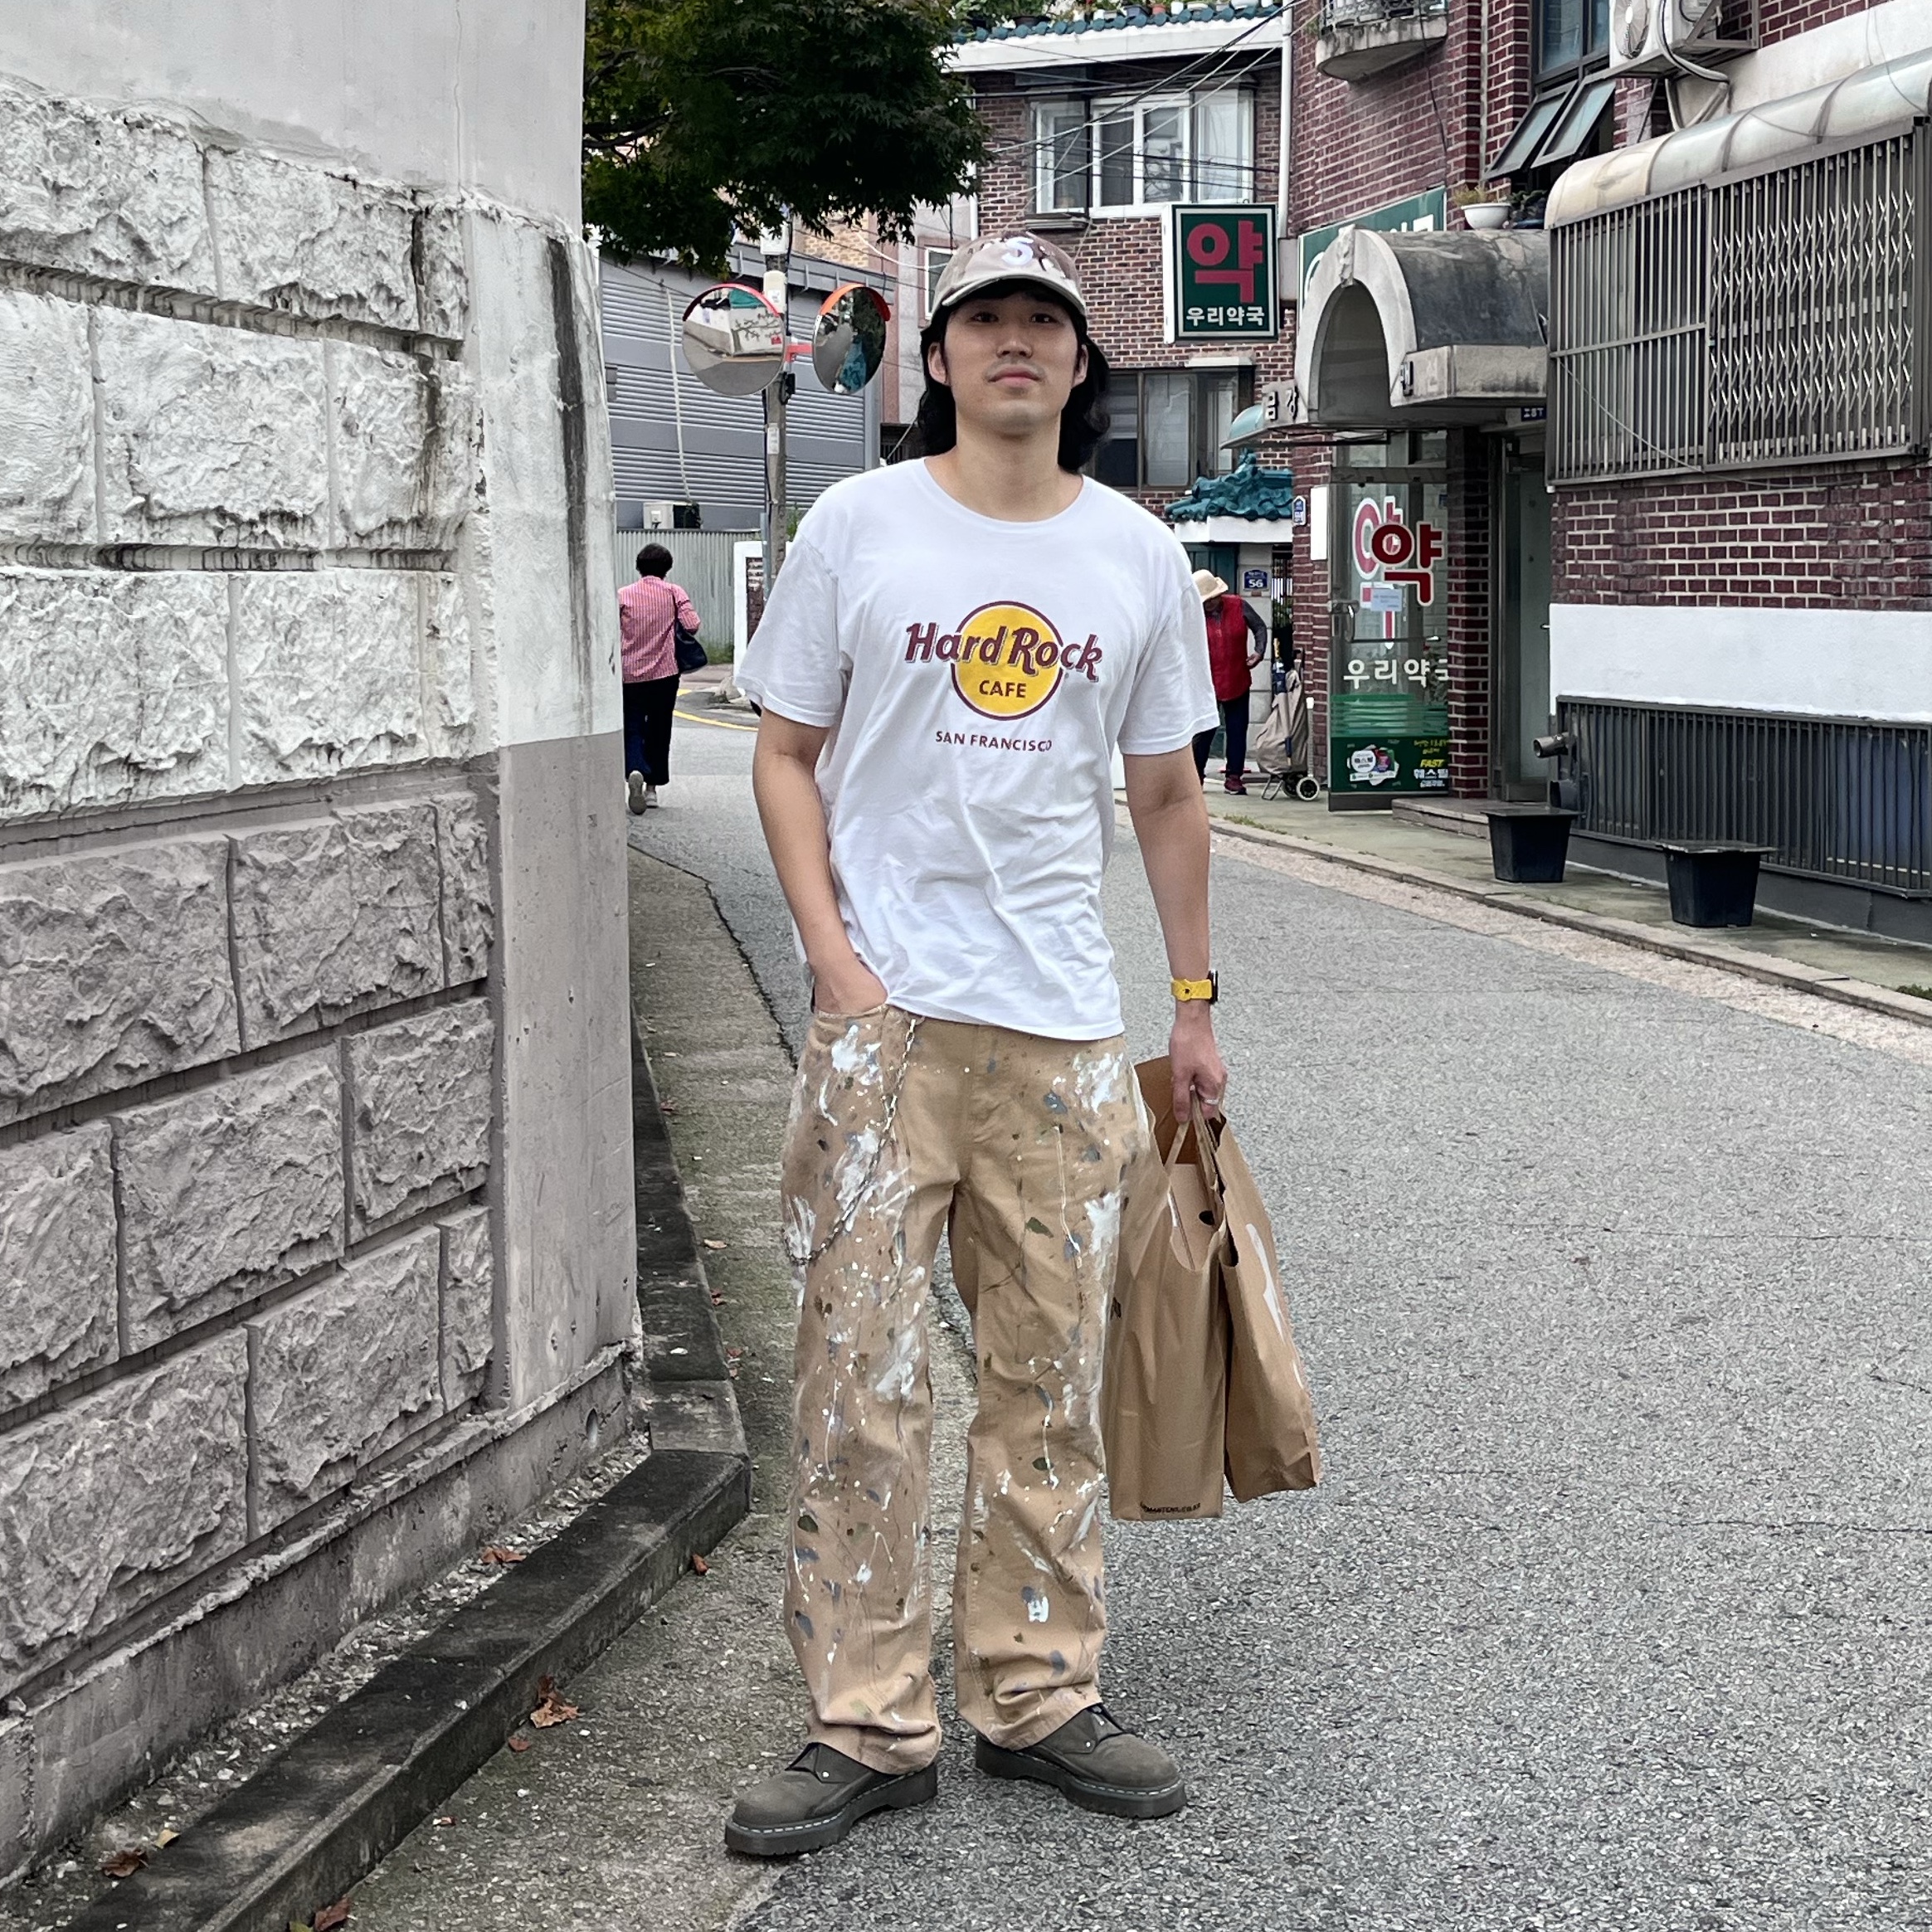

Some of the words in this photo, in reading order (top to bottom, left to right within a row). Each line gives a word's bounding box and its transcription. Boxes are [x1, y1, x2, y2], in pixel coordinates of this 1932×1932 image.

[1186, 220, 1263, 304] 약
[1186, 306, 1265, 326] 우리약국
[1371, 520, 1444, 606] 약
[904, 622, 1009, 666] Hard
[1006, 627, 1103, 683] Rock
[979, 679, 1027, 698] CAFE
[935, 730, 966, 746] SAN
[969, 733, 1053, 752] FRANCISCO
